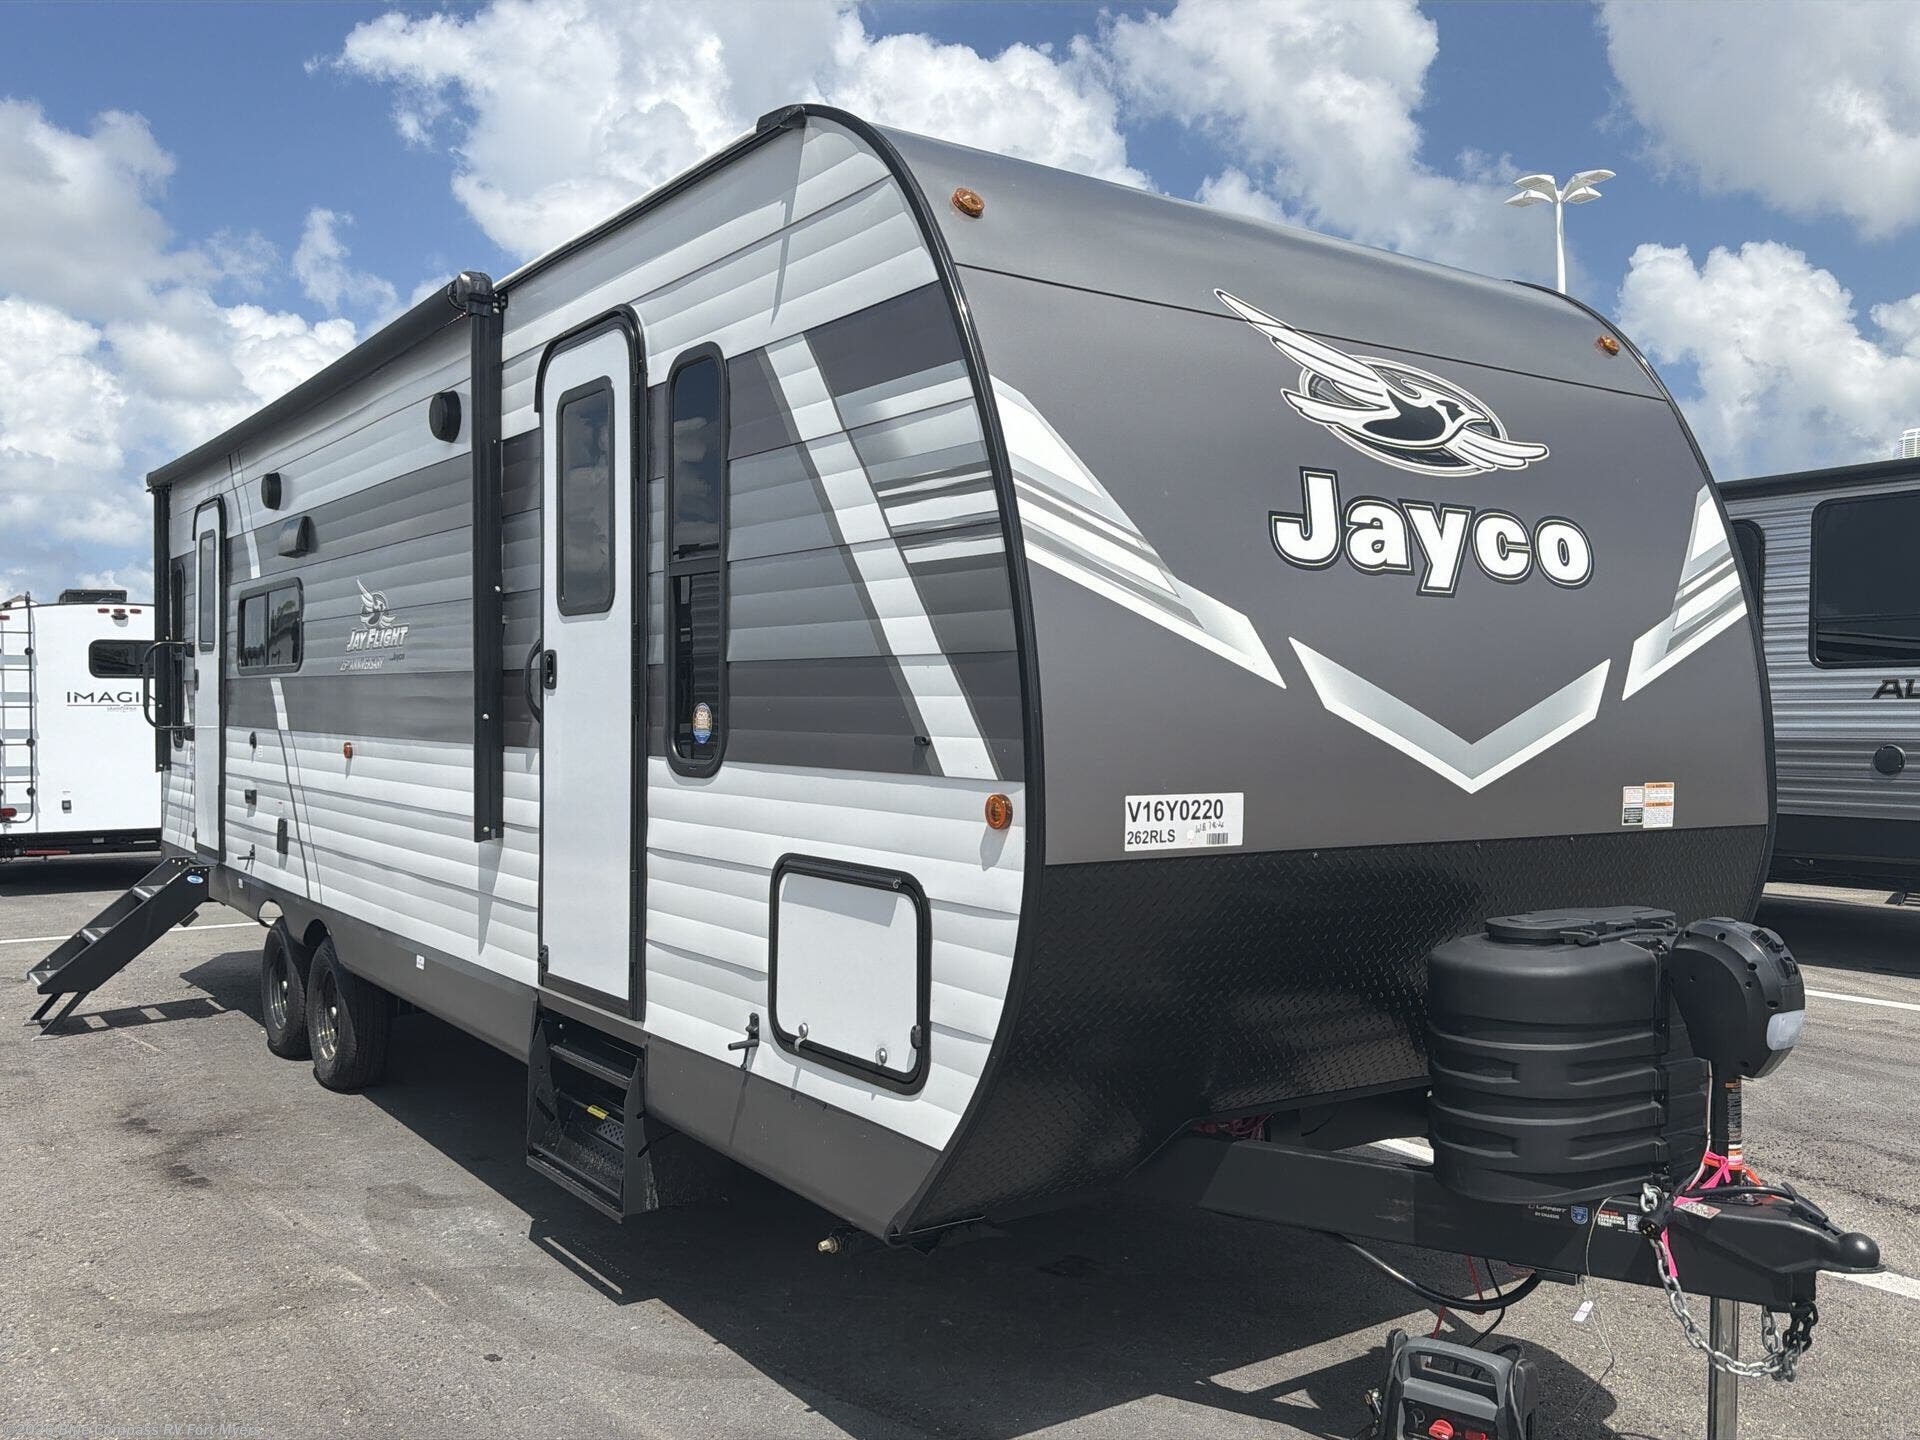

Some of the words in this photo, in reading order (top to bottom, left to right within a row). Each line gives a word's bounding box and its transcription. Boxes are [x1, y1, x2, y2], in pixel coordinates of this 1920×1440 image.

[1268, 466, 1594, 598] Jayco
[345, 629, 368, 653] JAY
[365, 623, 410, 649] FLIGHT
[66, 691, 155, 704] IMAGI
[1127, 798, 1225, 823] V16Y0220
[1126, 828, 1176, 846] 262RLS
